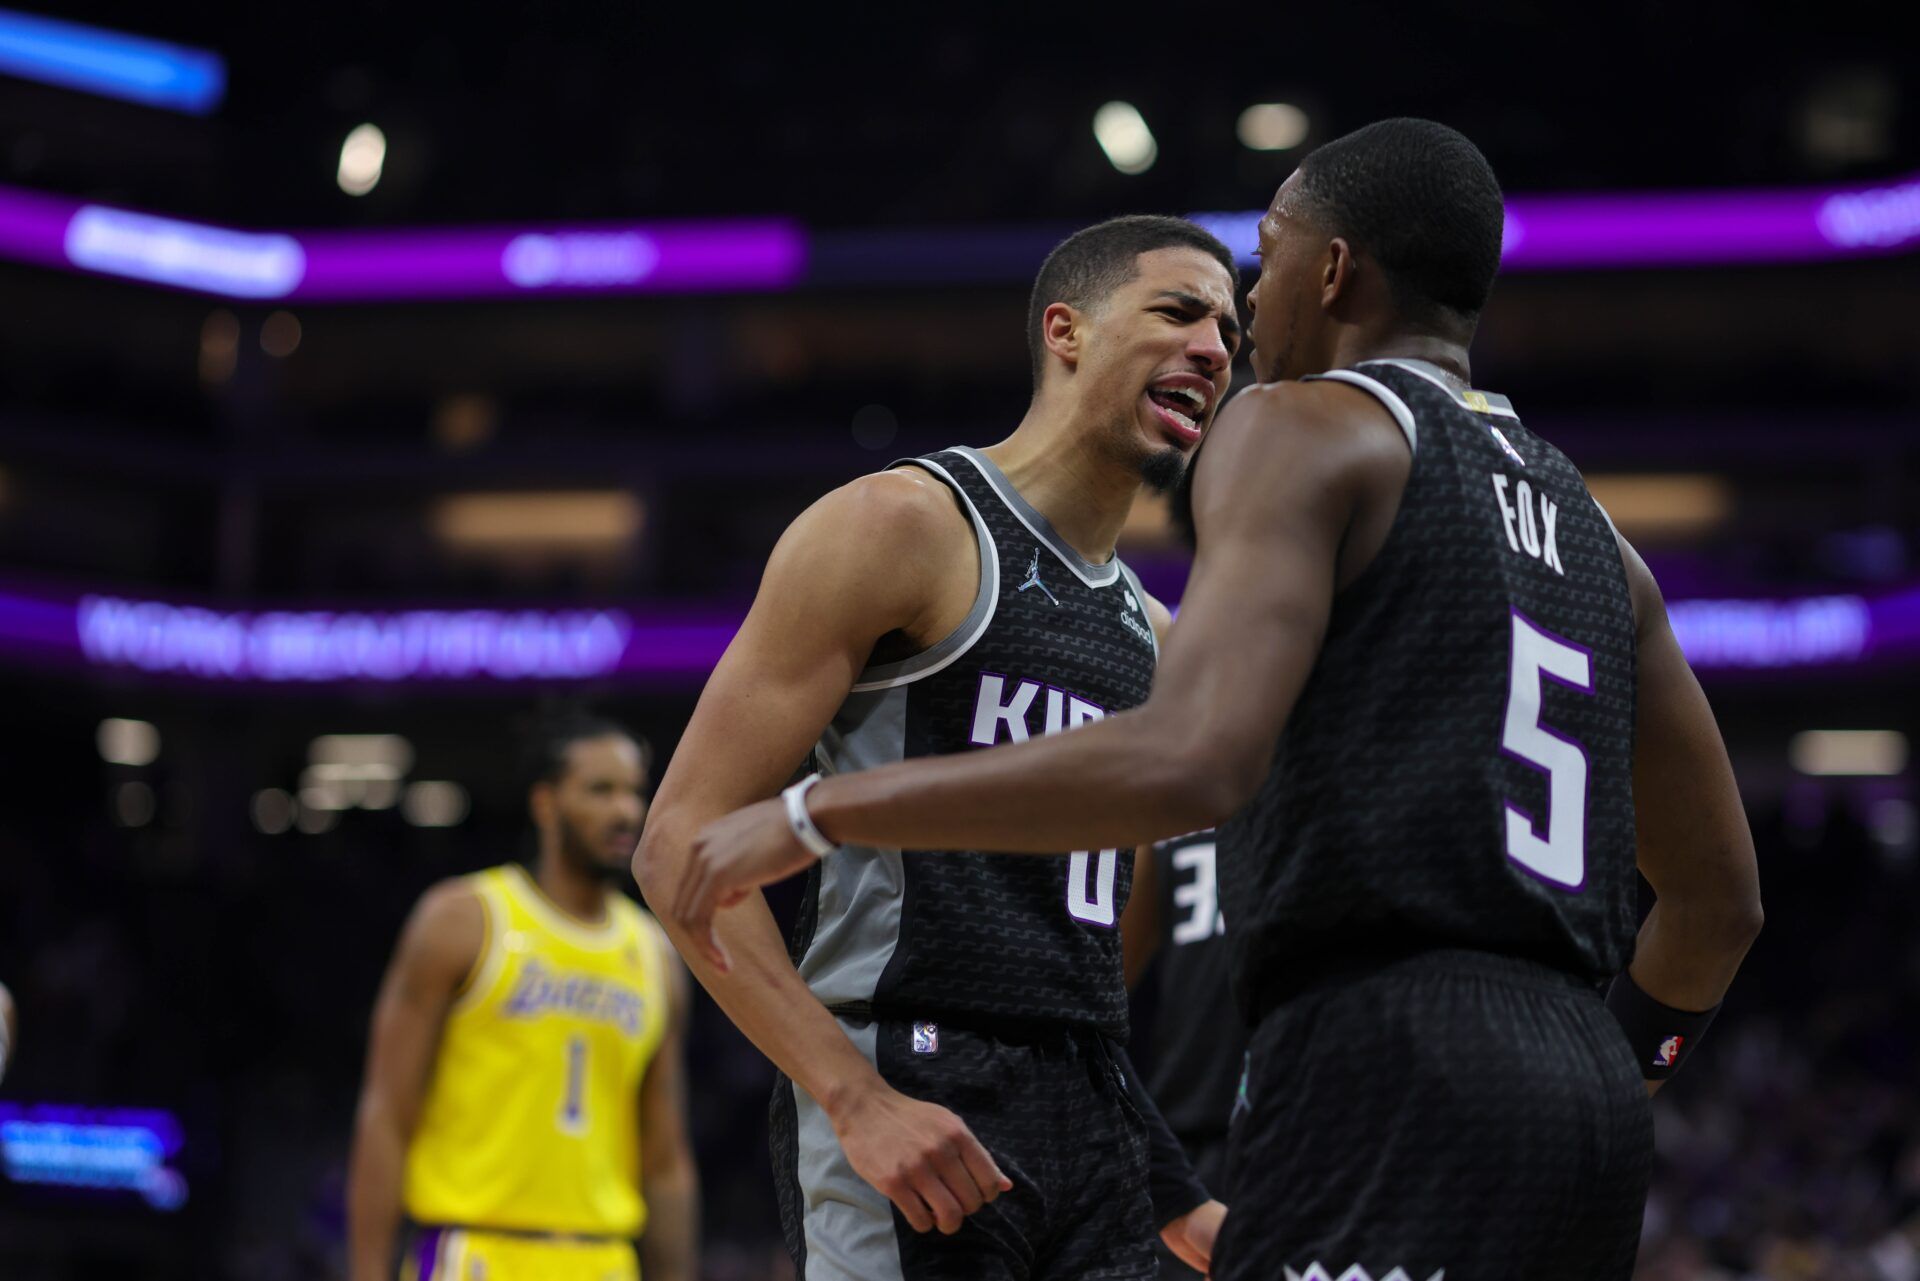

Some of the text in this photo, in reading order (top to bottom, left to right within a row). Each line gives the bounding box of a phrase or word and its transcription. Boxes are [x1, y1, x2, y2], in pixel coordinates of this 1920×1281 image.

[1491, 472, 1565, 577] FOX
[1500, 606, 1595, 892] 5
[556, 1033, 591, 1138] 1
